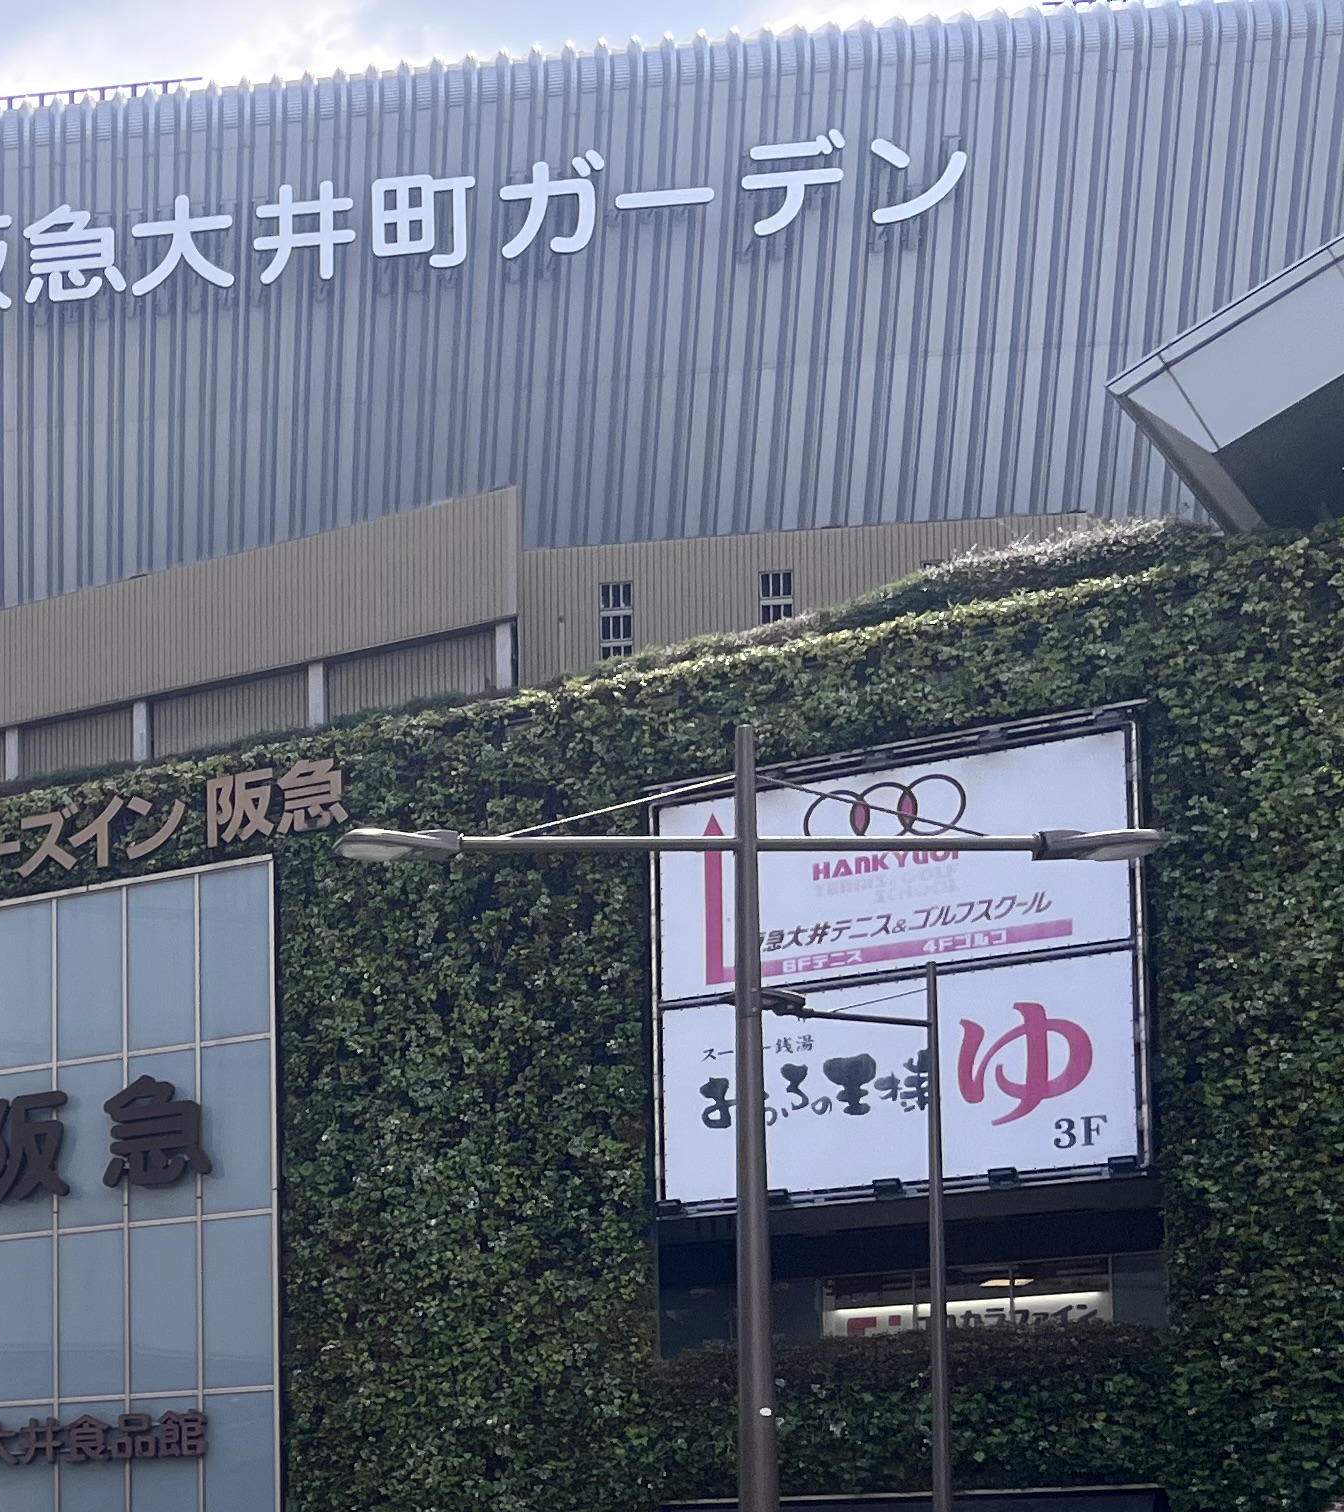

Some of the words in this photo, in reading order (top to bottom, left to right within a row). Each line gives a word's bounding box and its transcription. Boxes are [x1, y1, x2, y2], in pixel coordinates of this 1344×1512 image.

[206, 757, 349, 848] 阪急
[957, 1001, 1094, 1126] ゆ
[1053, 1114, 1108, 1149] 3F
